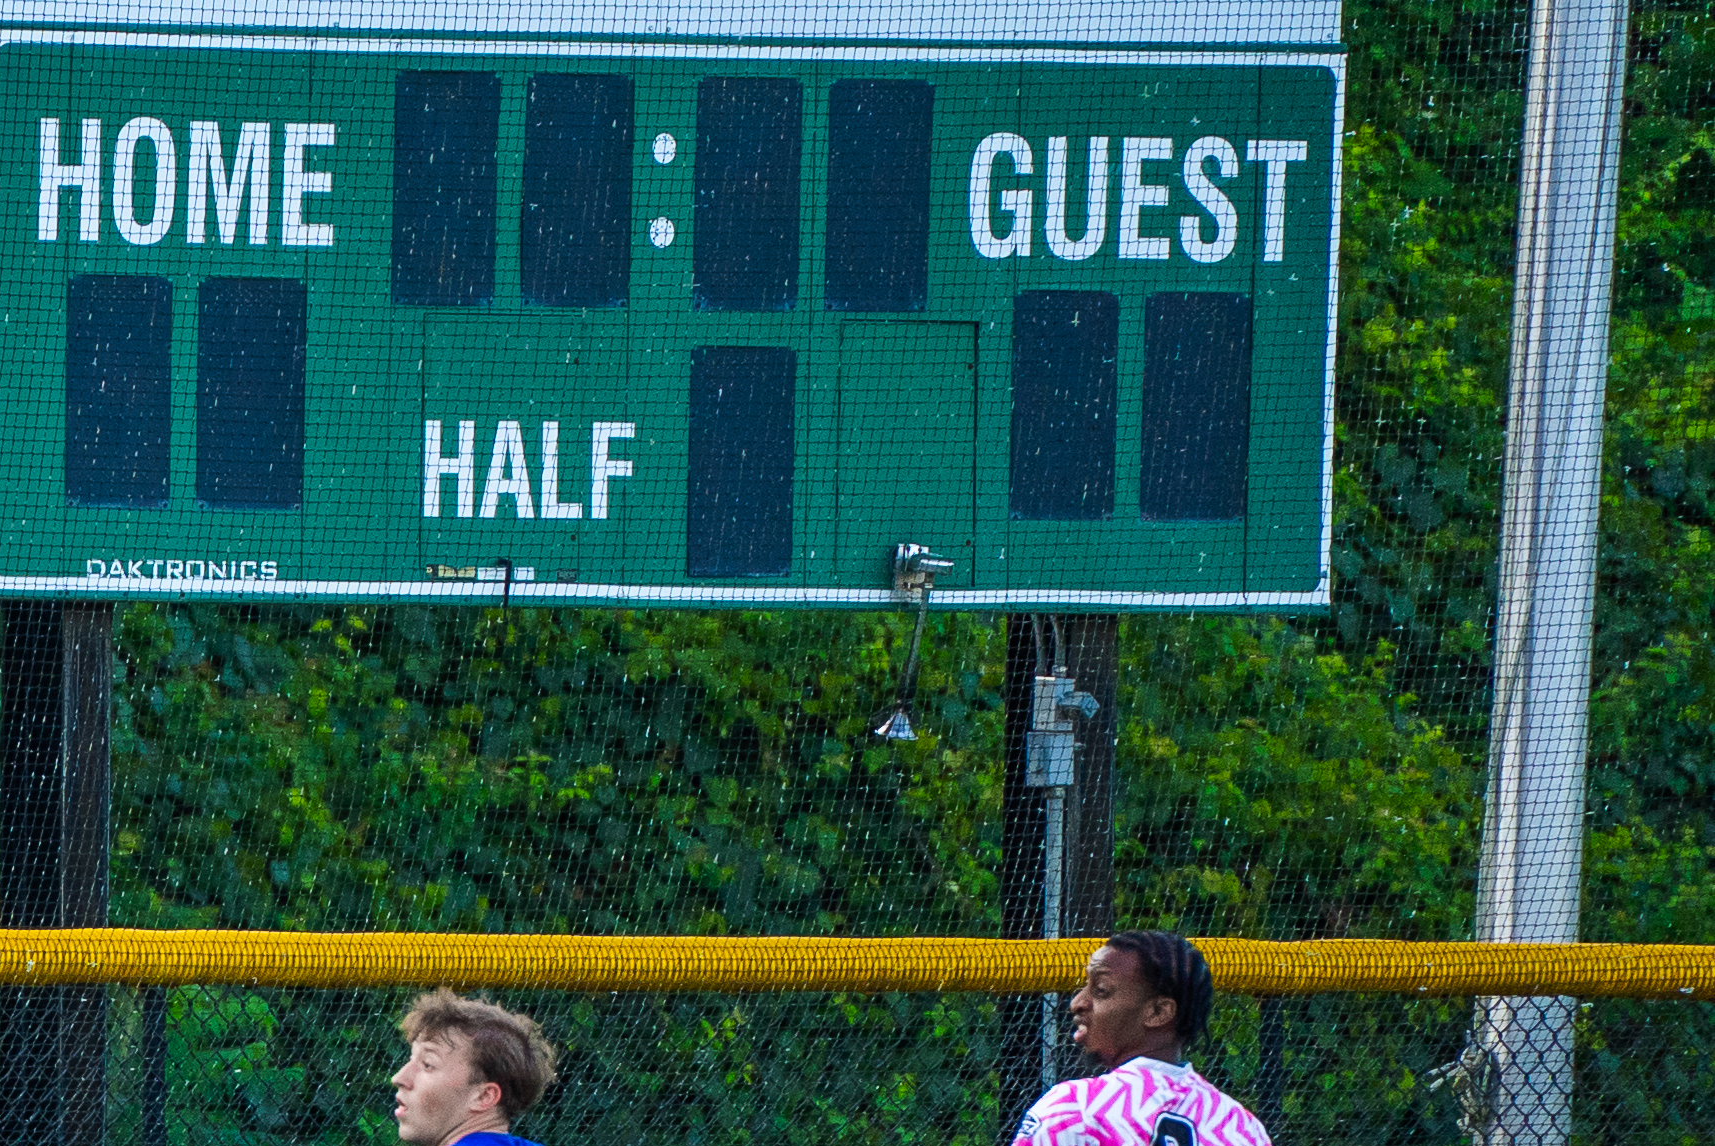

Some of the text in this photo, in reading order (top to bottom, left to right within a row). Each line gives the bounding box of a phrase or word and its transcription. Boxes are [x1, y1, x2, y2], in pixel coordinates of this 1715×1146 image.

[37, 116, 336, 246] HOME
[969, 131, 1309, 264] GUEST
[423, 419, 636, 519] HALF
[86, 558, 279, 581] DAKTRONICS
